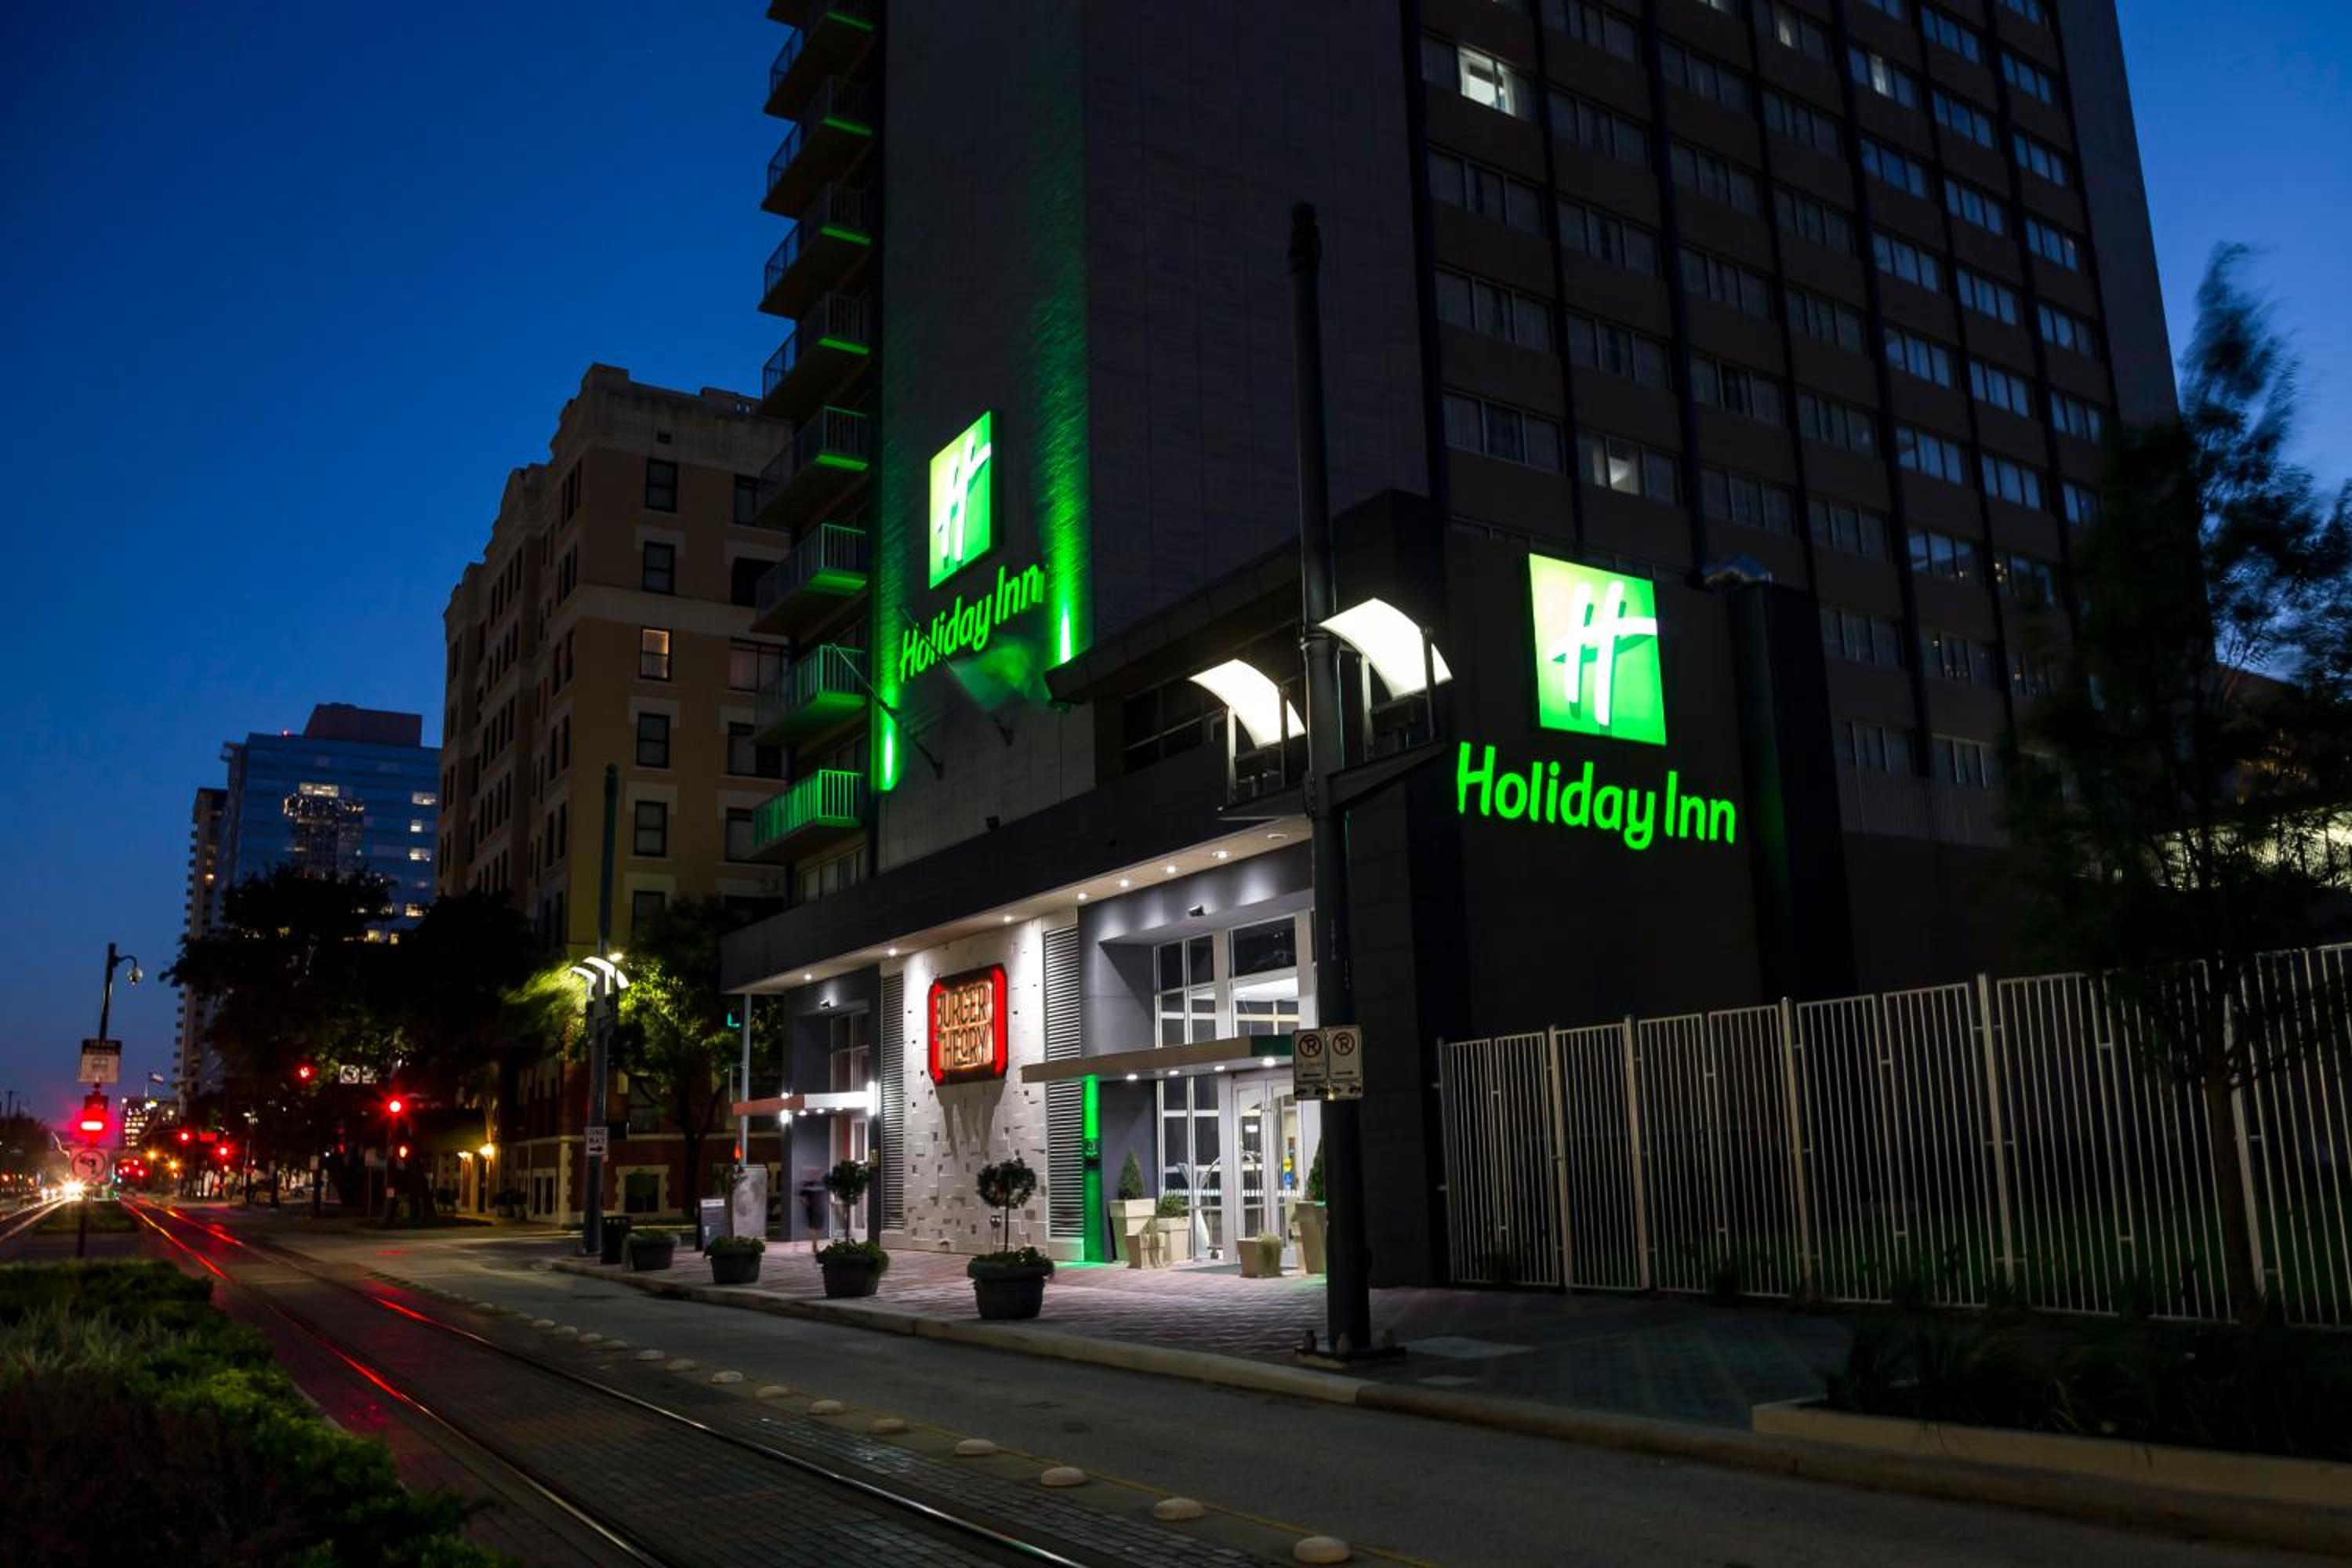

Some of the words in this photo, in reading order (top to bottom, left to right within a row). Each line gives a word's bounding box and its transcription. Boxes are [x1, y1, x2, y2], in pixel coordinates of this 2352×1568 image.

[900, 593, 993, 683] Holiday
[994, 564, 1045, 625] Inn
[1456, 741, 1657, 851] Holiday
[1664, 770, 1737, 844] Inn
[936, 983, 989, 1028] BURGER
[936, 1024, 989, 1068] THEORY
